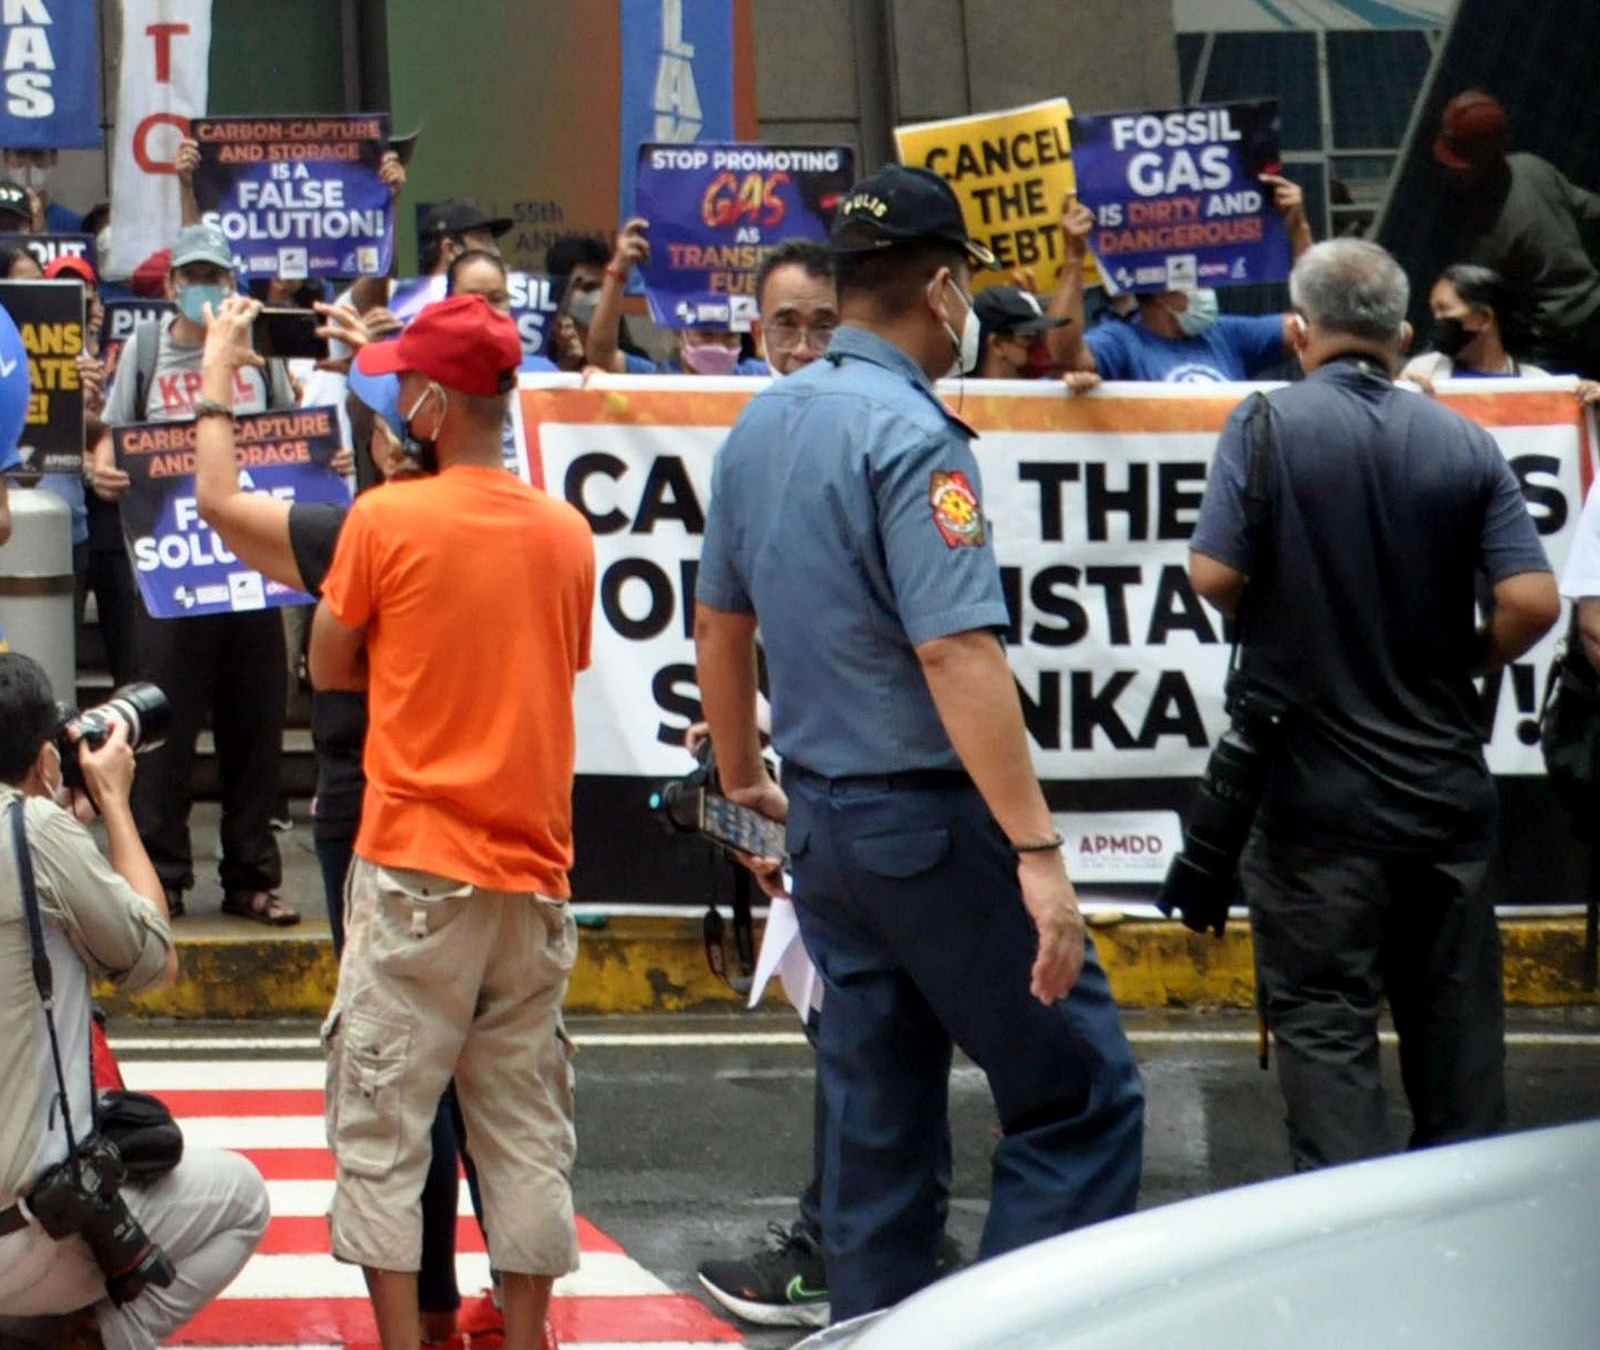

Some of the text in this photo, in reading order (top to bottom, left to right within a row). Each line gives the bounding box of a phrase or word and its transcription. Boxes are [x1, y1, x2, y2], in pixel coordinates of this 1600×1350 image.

[198, 119, 383, 142] CARBON-CAPTURE
[1111, 109, 1242, 151] FOSSIL
[219, 141, 362, 164] AND STORAGE
[651, 149, 839, 173] STOP PROMOTING
[925, 126, 1072, 182] CANCEL
[270, 161, 310, 180] IS A
[1127, 146, 1233, 197] GAS
[237, 180, 345, 211] FALSE
[702, 171, 792, 230] GAS
[842, 192, 890, 219] PULIS
[971, 178, 1048, 225] THE
[1099, 192, 1263, 228] IS DIRTY AND
[201, 208, 386, 241] SOLUTION!
[736, 227, 761, 244] AS
[1098, 216, 1264, 255] DANGEROUS!
[667, 244, 764, 268] TRANSI
[709, 272, 758, 295] FUE
[150, 454, 197, 479] AND
[1017, 461, 1201, 542] THE
[1079, 835, 1164, 854] APMDD
